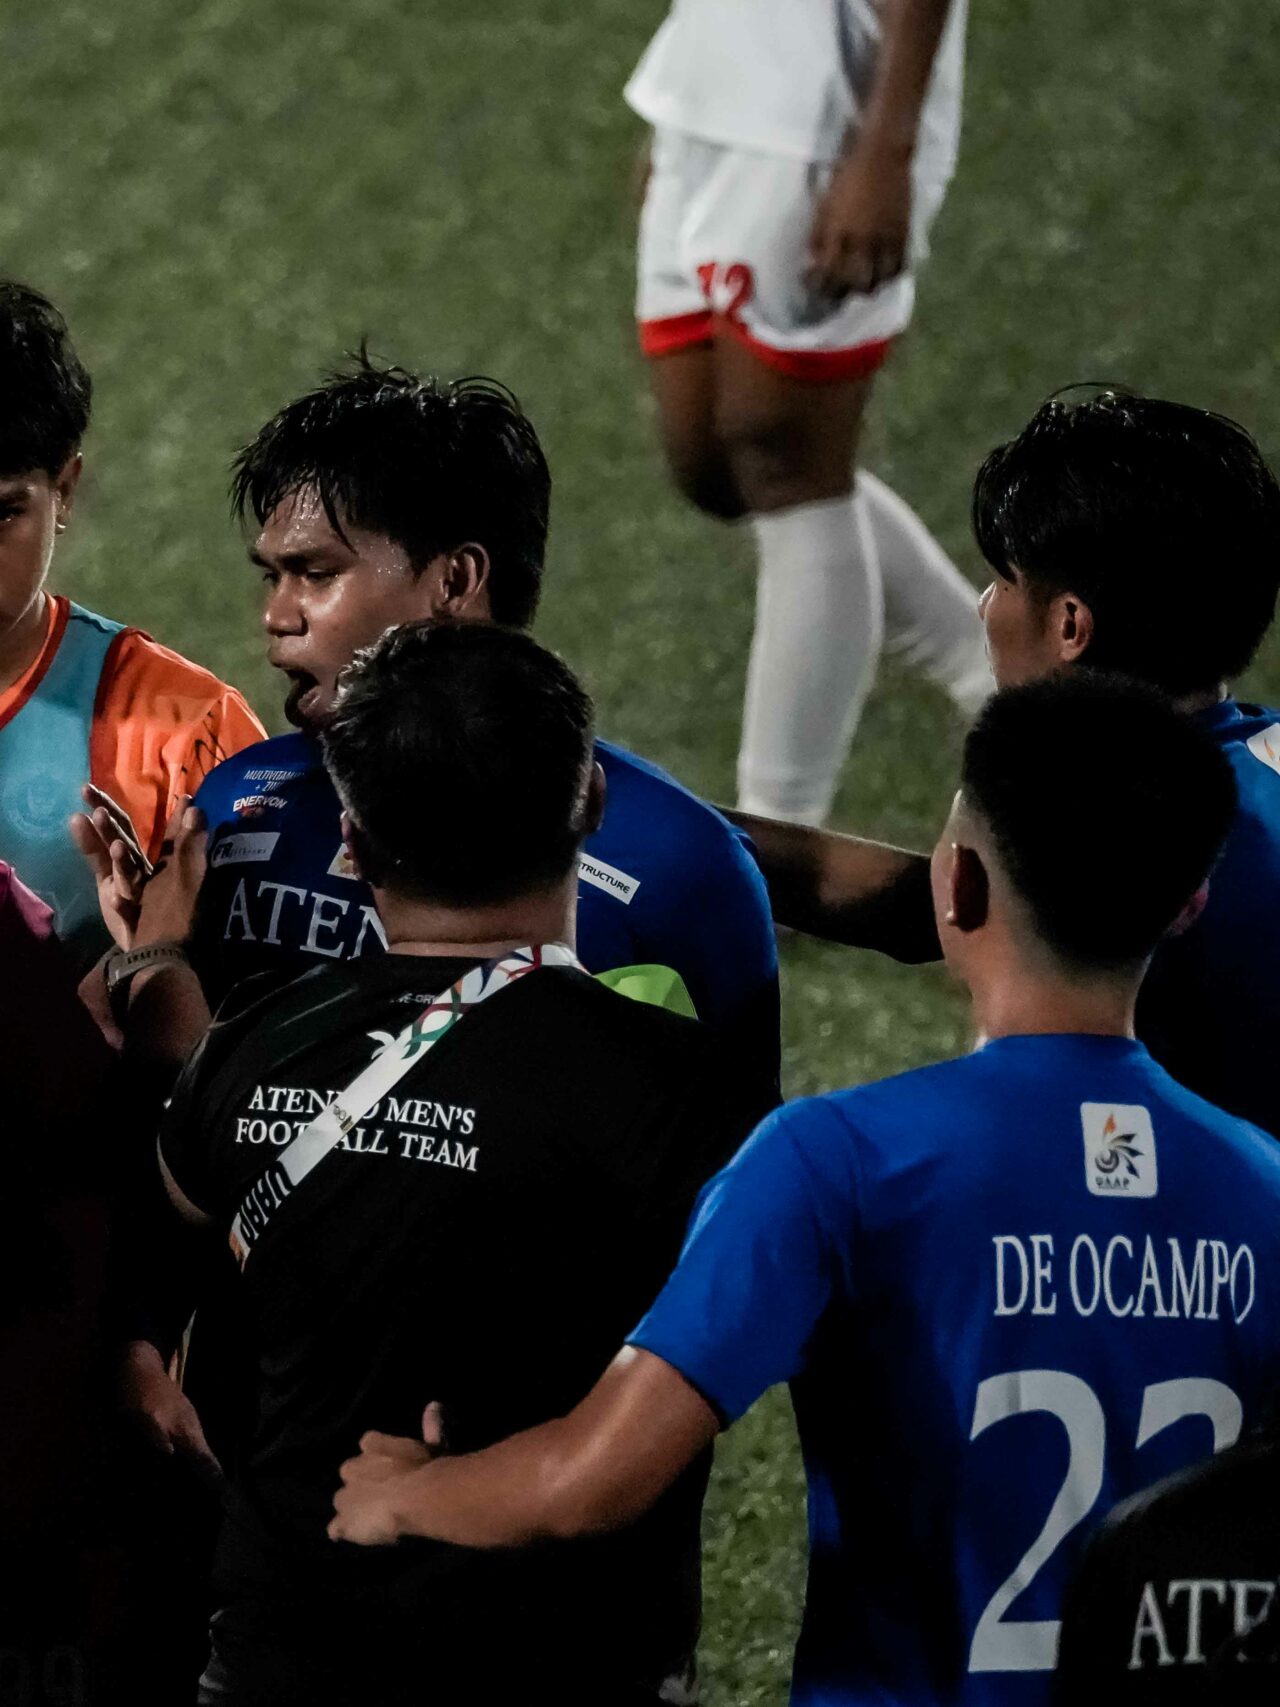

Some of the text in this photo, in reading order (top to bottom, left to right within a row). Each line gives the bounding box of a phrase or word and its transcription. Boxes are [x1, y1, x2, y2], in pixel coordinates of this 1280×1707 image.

[233, 795, 288, 812] ENERVON
[248, 1084, 380, 1120] ATEN
[385, 1096, 477, 1135] MEN'S
[235, 1118, 389, 1155] FOOTALL
[398, 1131, 480, 1172] TEAM
[992, 1233, 1256, 1325] DE OCAMPO
